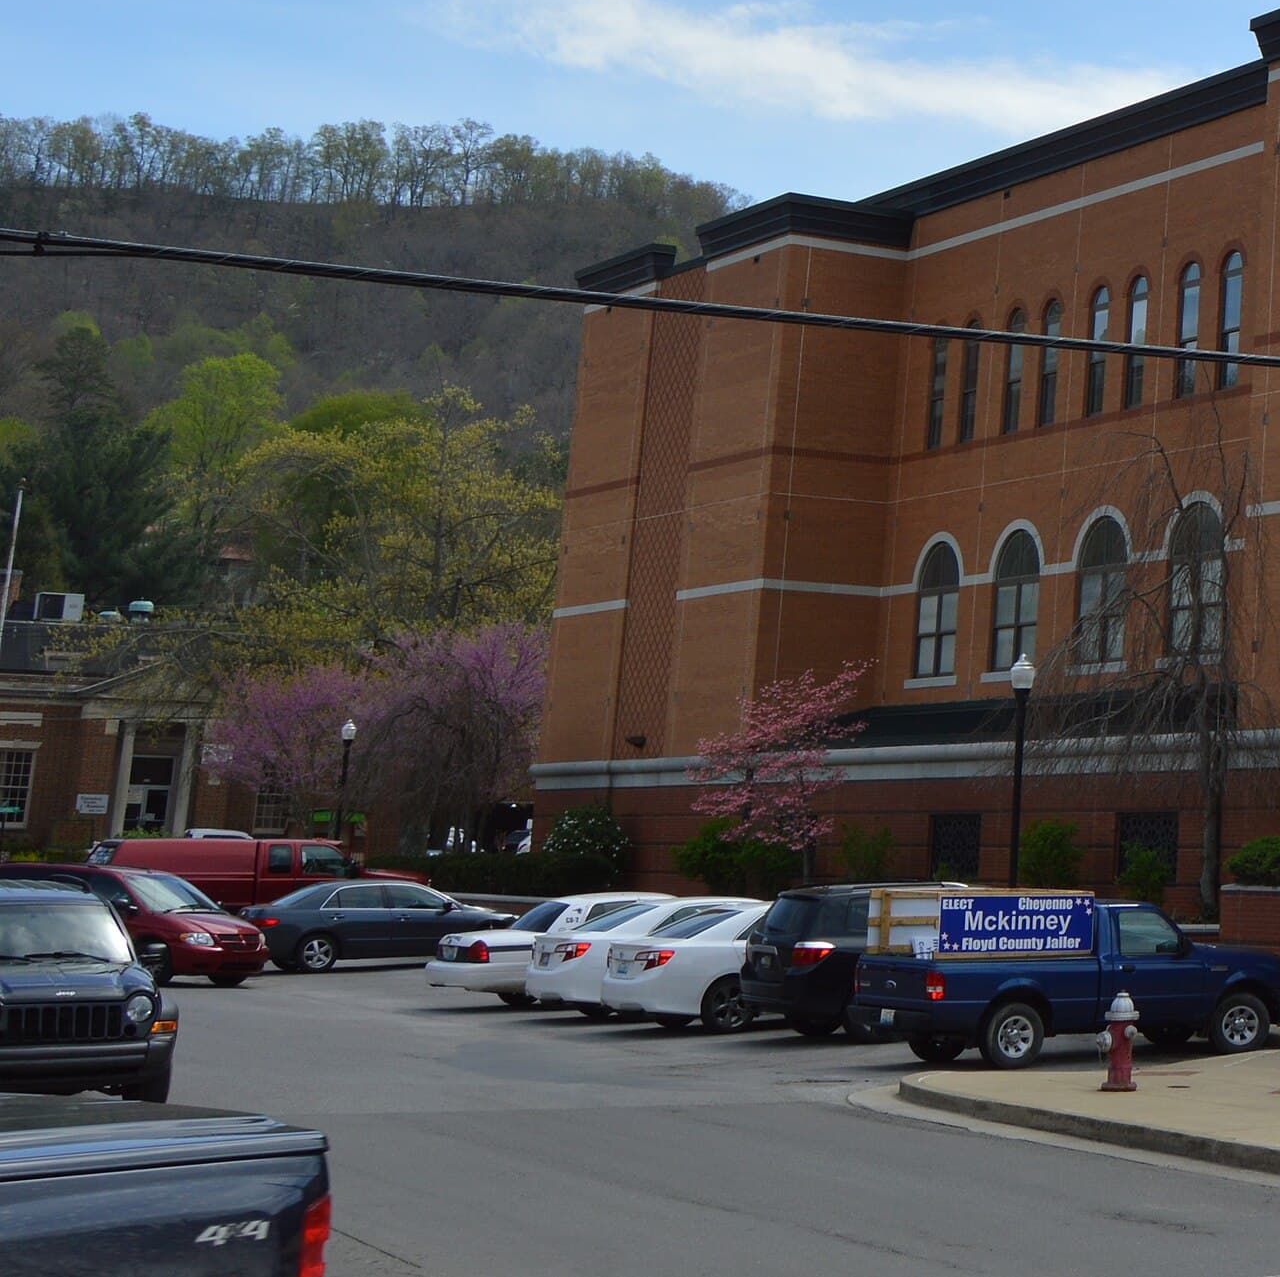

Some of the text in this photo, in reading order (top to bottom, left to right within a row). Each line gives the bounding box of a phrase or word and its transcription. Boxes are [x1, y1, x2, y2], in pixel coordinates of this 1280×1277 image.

[942, 897, 1073, 911] ELECT Cheyenne
[964, 910, 1072, 935] Mckinney
[961, 936, 1081, 951] Floyd County Jailer
